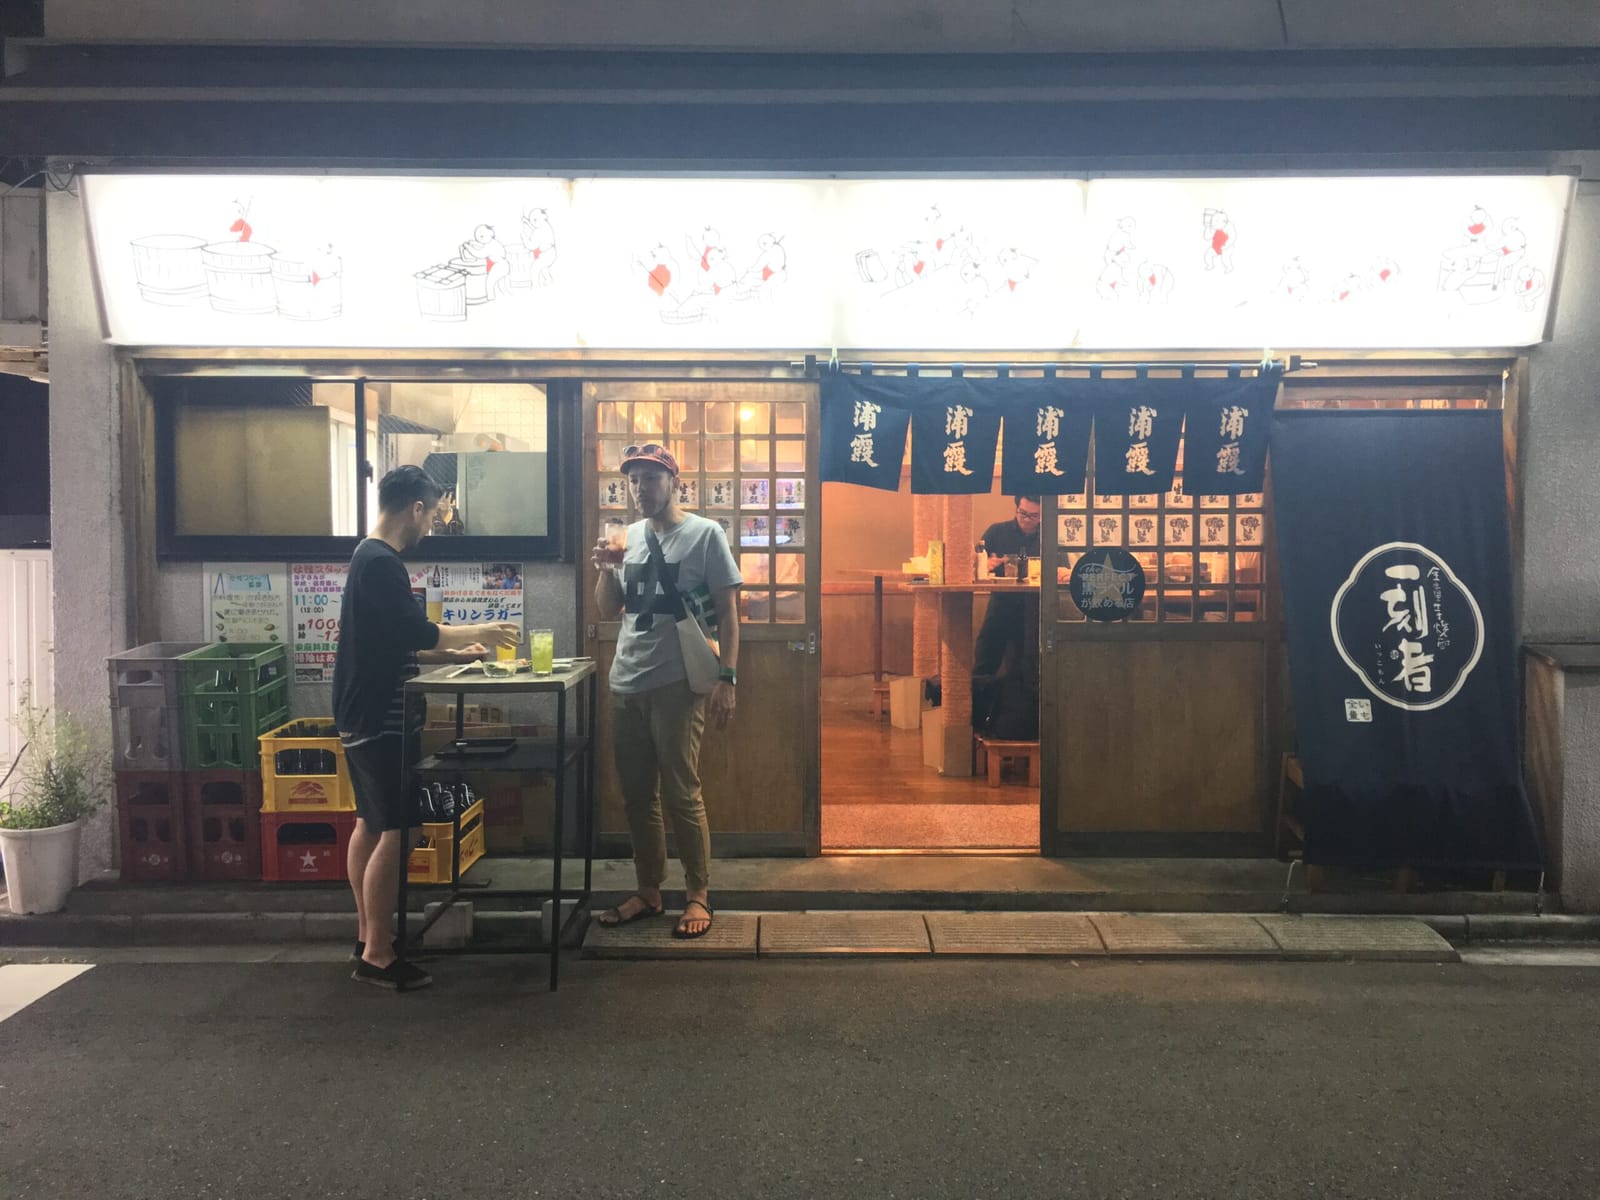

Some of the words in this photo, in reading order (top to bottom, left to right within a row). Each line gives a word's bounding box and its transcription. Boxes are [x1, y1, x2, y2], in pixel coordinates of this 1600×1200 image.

[850, 400, 882, 468] 浦霞
[943, 404, 974, 476] 浦霞
[1034, 405, 1065, 476] 浦霞
[1125, 405, 1157, 476] 浦霞
[1216, 405, 1249, 476] 浦霞
[1080, 597, 1135, 608] が飲める店
[1081, 573, 1133, 581] PERFECT
[1081, 581, 1135, 595] 黒ラベル
[443, 608, 523, 621] キリンラガー
[1380, 564, 1434, 692] 一刻者
